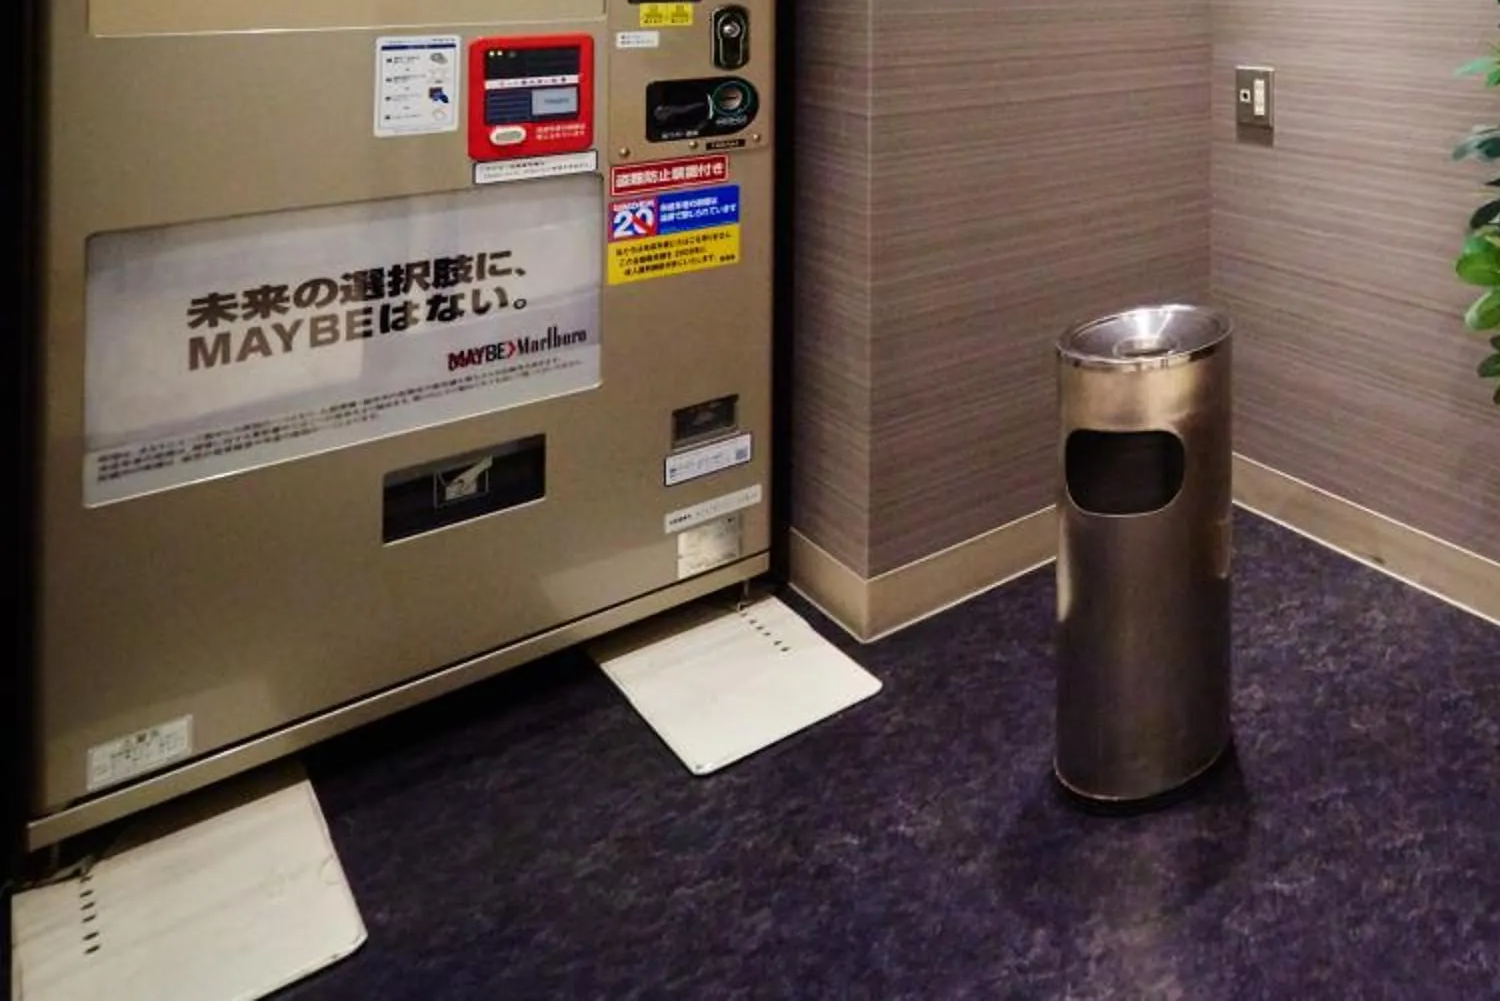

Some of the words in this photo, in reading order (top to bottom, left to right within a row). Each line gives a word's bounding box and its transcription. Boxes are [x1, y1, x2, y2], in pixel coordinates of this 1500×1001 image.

[186, 250, 527, 329] 未来の選択肢に、
